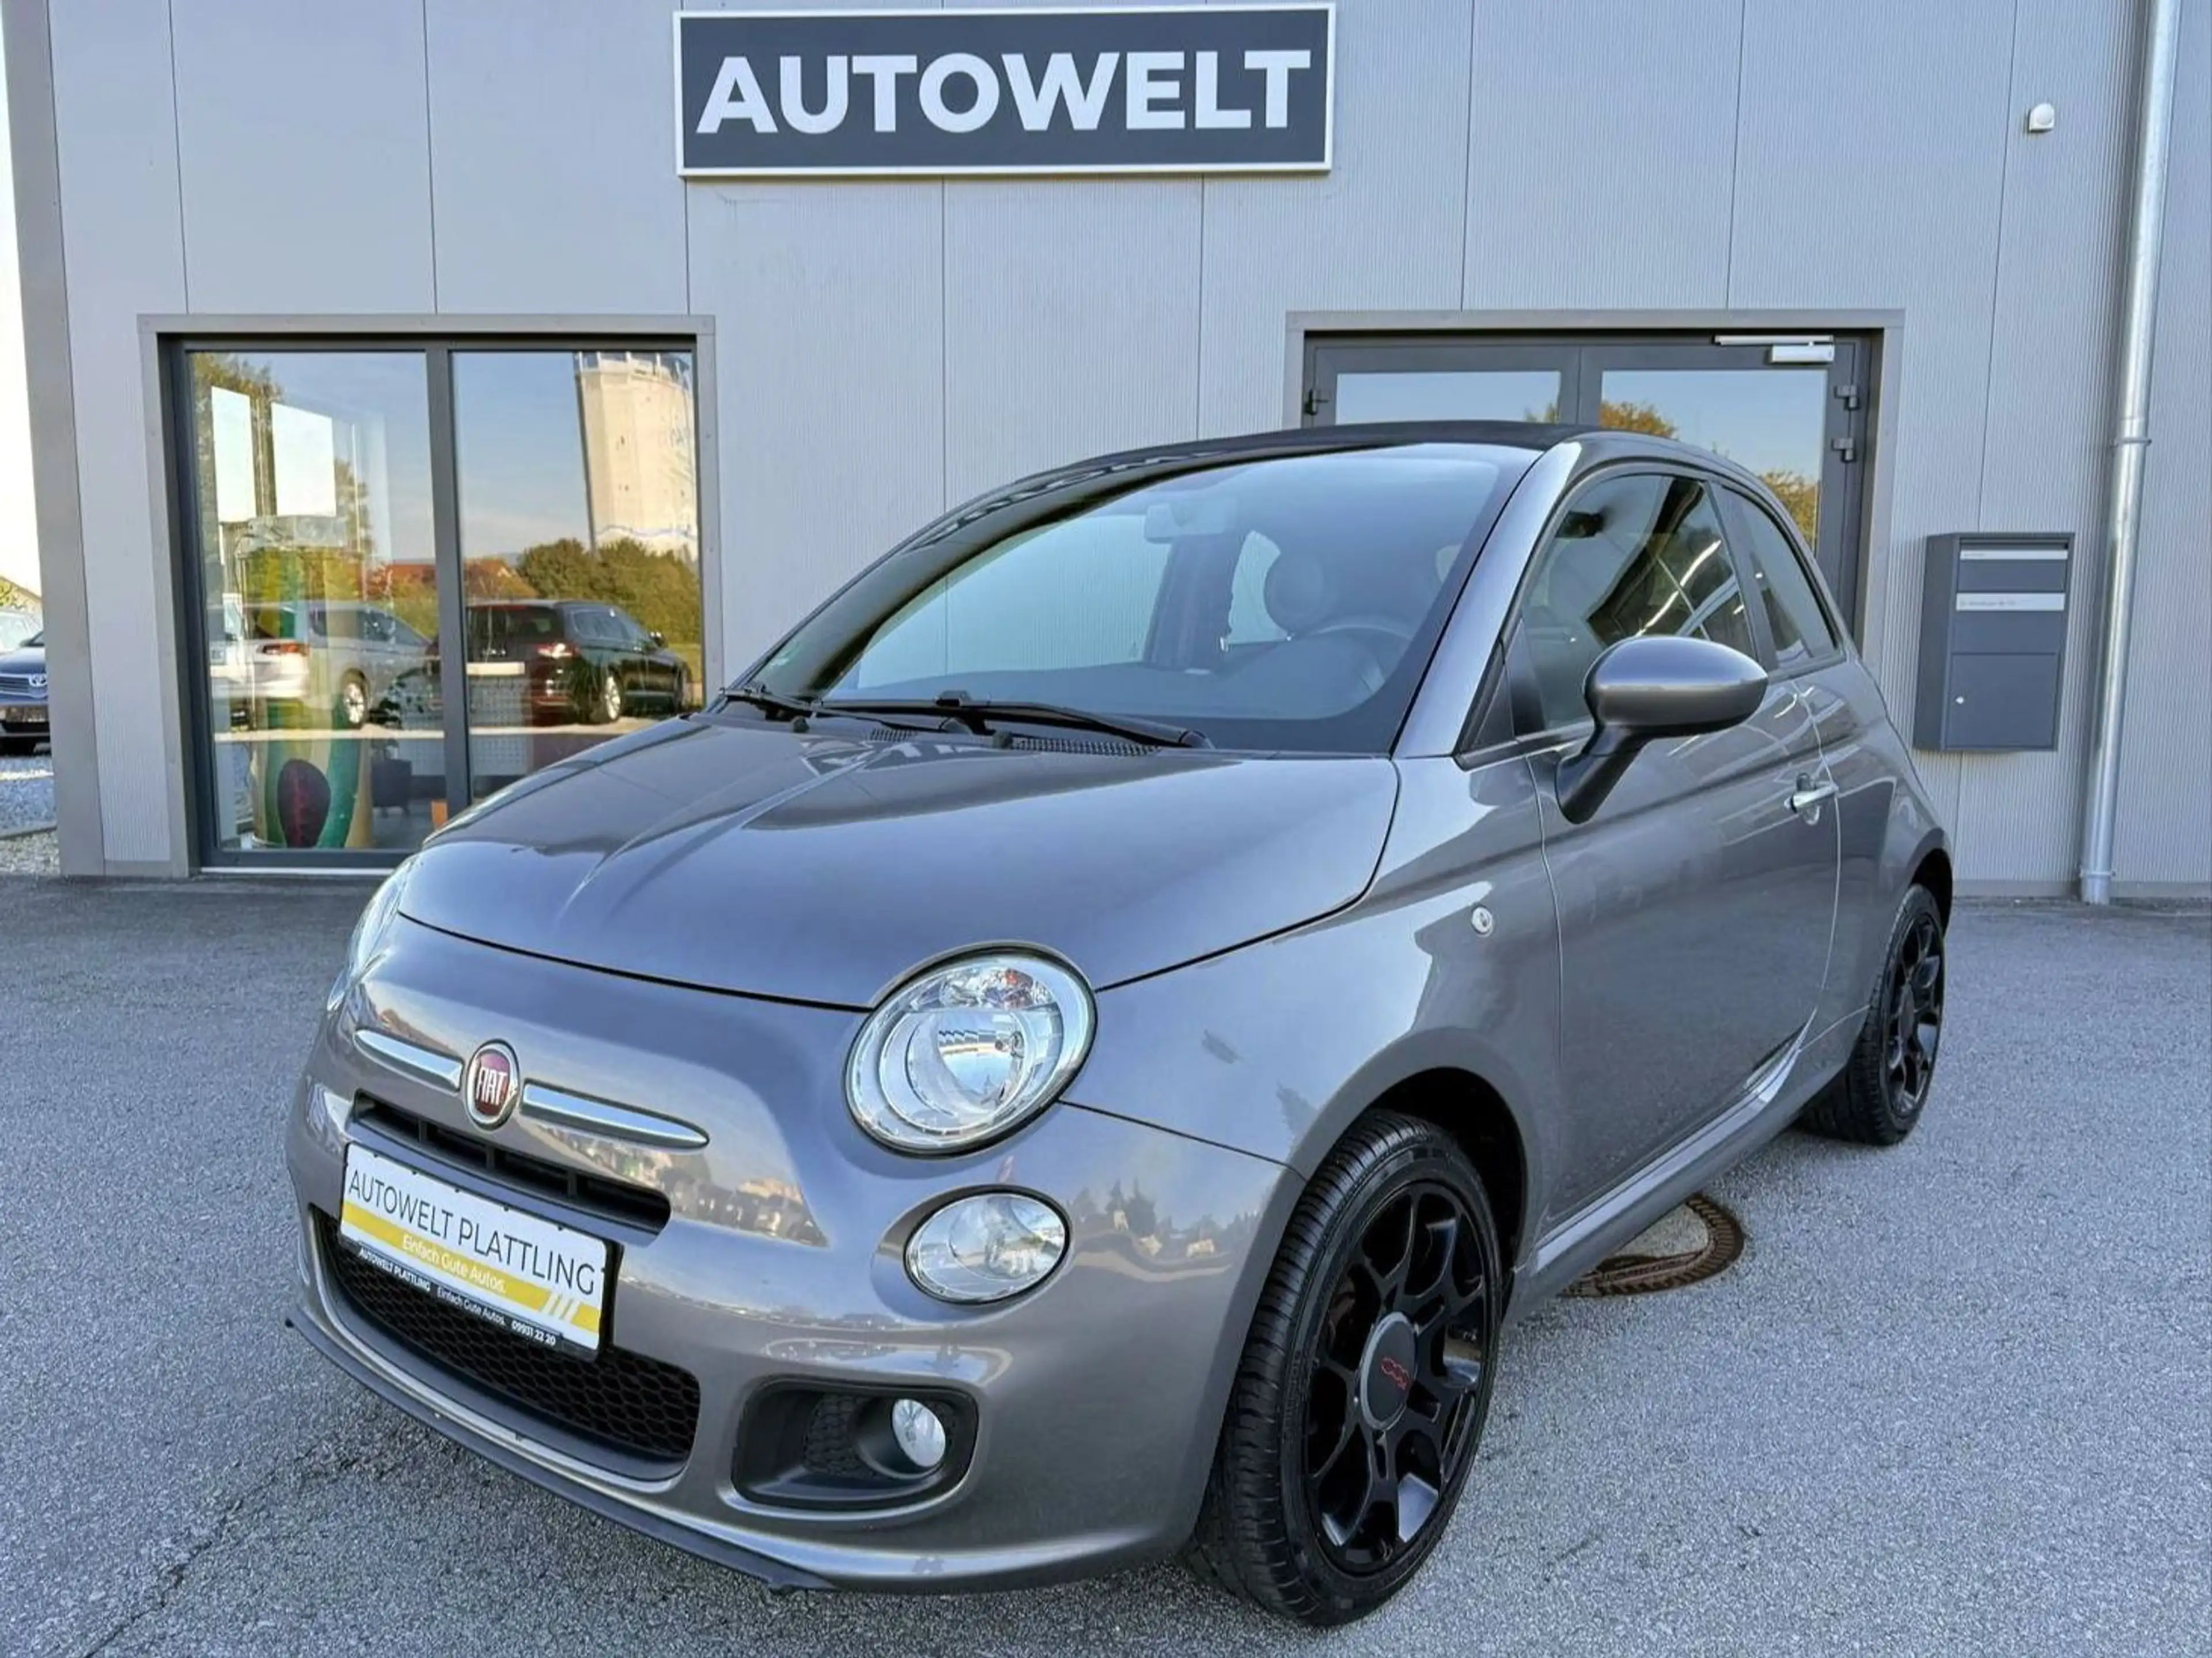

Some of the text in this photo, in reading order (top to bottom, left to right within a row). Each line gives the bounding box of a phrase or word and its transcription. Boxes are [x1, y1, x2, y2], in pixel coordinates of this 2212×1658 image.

[695, 50, 1311, 134] AUTOWELT
[476, 1066, 508, 1105] FIAT
[348, 1169, 594, 1295] AUTOWELT PLATTLING
[403, 1233, 440, 1264] Einfach
[441, 1253, 468, 1277] Gute
